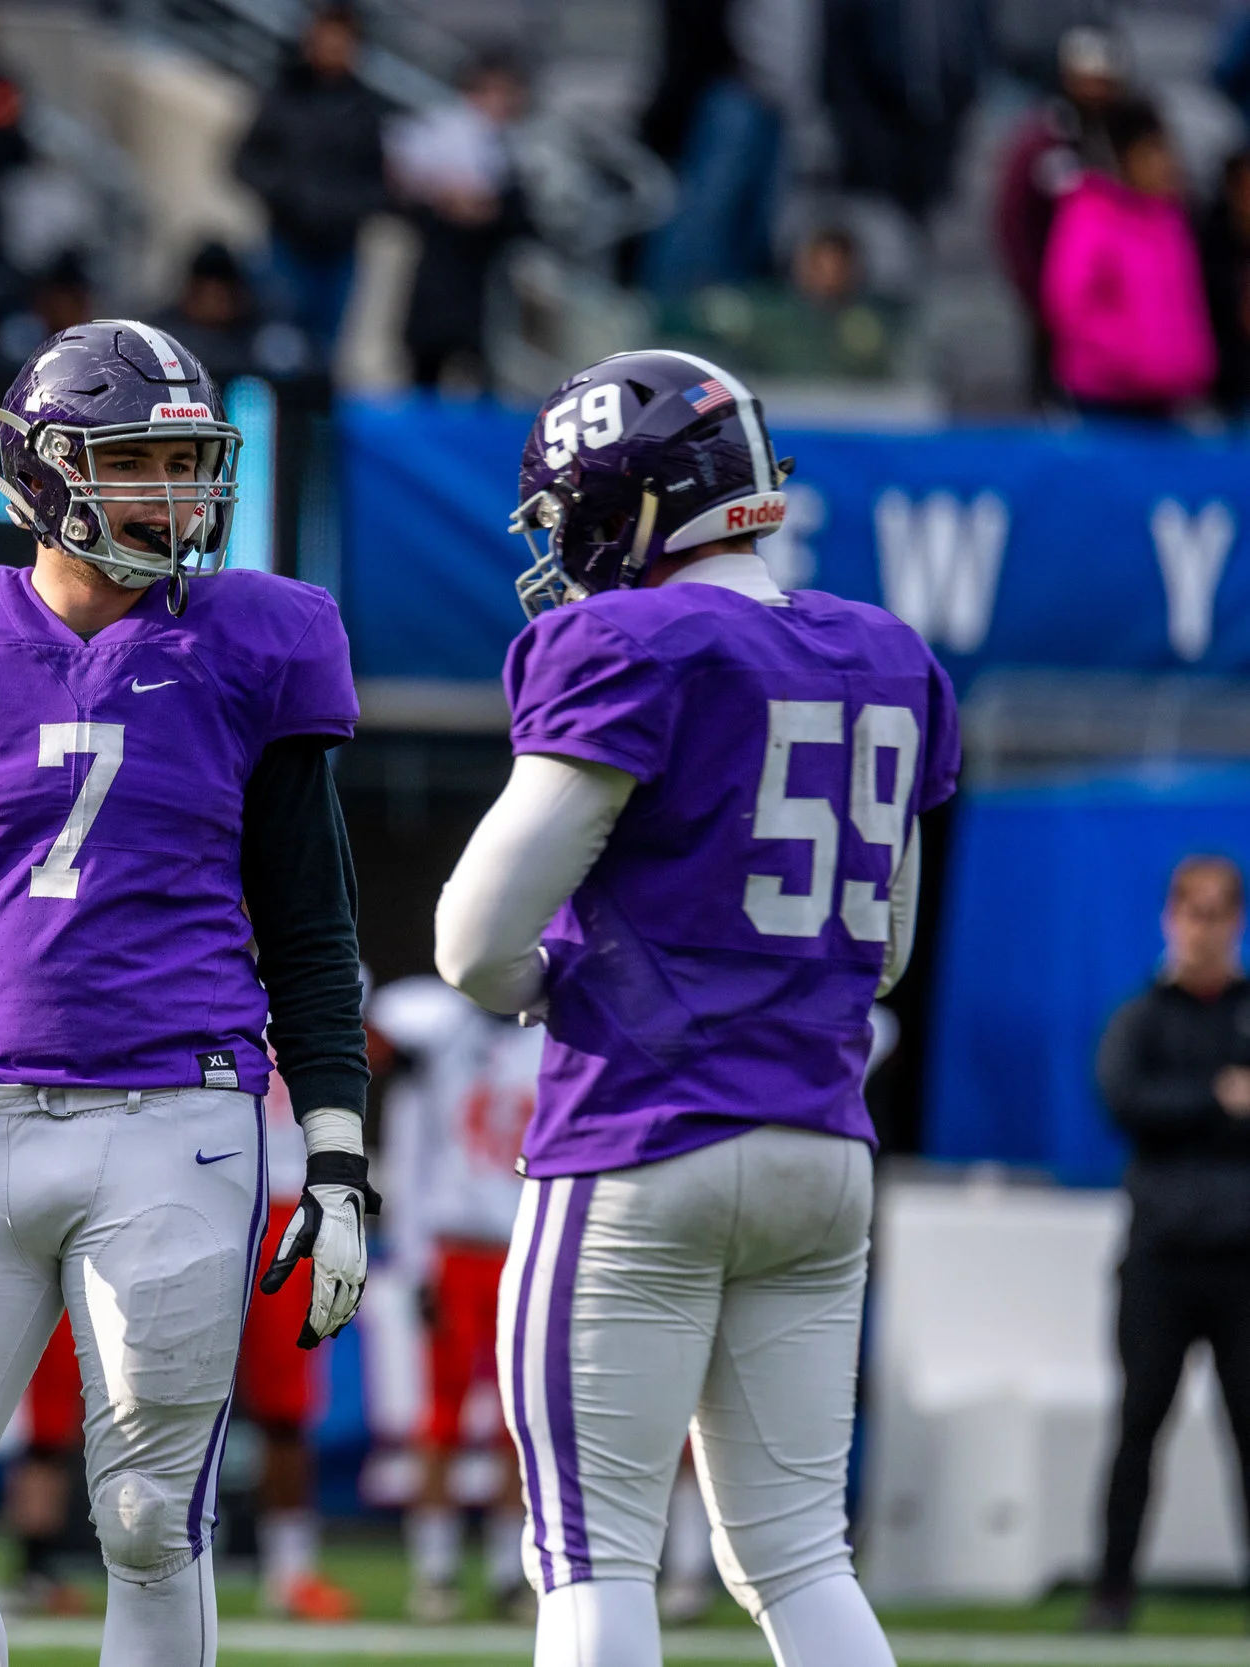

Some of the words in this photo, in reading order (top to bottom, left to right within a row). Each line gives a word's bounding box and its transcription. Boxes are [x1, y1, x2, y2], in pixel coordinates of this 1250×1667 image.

[160, 407, 208, 419] Riddell
[544, 383, 624, 470] 59
[29, 722, 125, 900] 7
[742, 700, 919, 943] 59
[207, 1054, 229, 1067] XL
